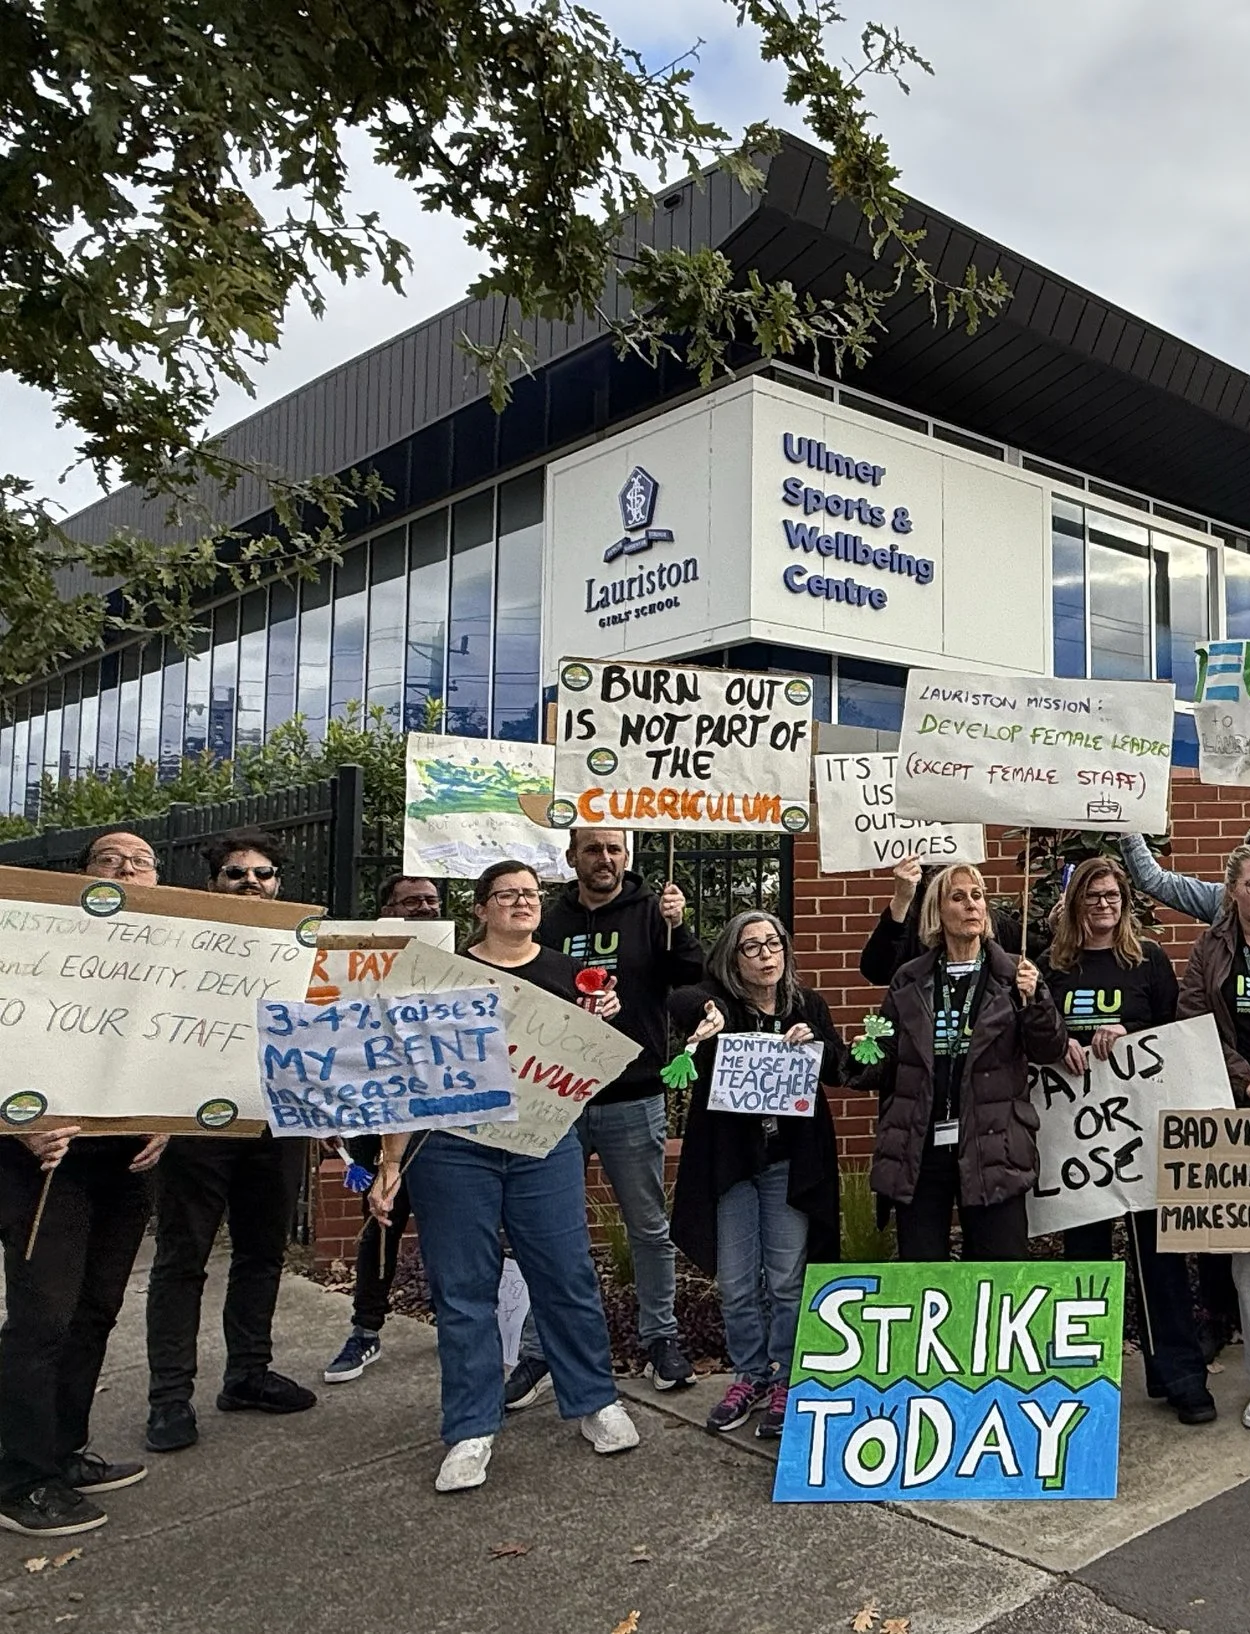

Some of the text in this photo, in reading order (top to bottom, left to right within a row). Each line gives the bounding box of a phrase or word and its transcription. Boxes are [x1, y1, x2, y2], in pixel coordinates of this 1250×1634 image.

[783, 432, 886, 487] Ullmer
[783, 477, 913, 533] Sports &
[783, 520, 934, 585] Wellbeing
[584, 557, 699, 614] Lauriston
[783, 564, 888, 610] Centre
[635, 597, 680, 619] SCHOOL
[600, 666, 784, 710] BURN OUT
[919, 686, 1016, 710] LAURISTON
[565, 708, 808, 752] IS NOT PART OF
[918, 713, 1022, 742] DEVELOP
[1030, 727, 1103, 751] FEMALE
[646, 748, 715, 780] THE
[827, 757, 870, 782] IT'S
[906, 751, 973, 781] (EXCEPT
[986, 764, 1058, 784] FEMALE
[1077, 770, 1146, 799] STAFF)
[577, 787, 784, 824] CURRICULUM
[864, 784, 894, 806] US
[874, 835, 957, 862] VOICES
[0, 909, 300, 963] RISTON TEACH GIRLS TO
[348, 951, 399, 982] PAY
[197, 971, 281, 999] DENY
[1064, 989, 1122, 1015] IEU
[46, 998, 129, 1037] YOUR
[143, 1012, 251, 1052] STAFF
[386, 993, 499, 1027] raises?
[265, 1044, 337, 1082] MY
[721, 1056, 816, 1073] ME USE MY
[768, 1041, 806, 1054] MAKE
[1108, 1035, 1164, 1082] US
[443, 1066, 476, 1090] is
[717, 1069, 819, 1095] TEACHER
[273, 1098, 403, 1128] BIGGER
[729, 1091, 790, 1111] VOICE
[1074, 1096, 1143, 1140] OR
[1163, 1115, 1217, 1150] BAD
[1033, 1137, 1143, 1198] LOSE
[1161, 1205, 1221, 1232] MAKE
[800, 1277, 1109, 1375] STRIKE
[796, 1396, 1090, 1490] TODAY
